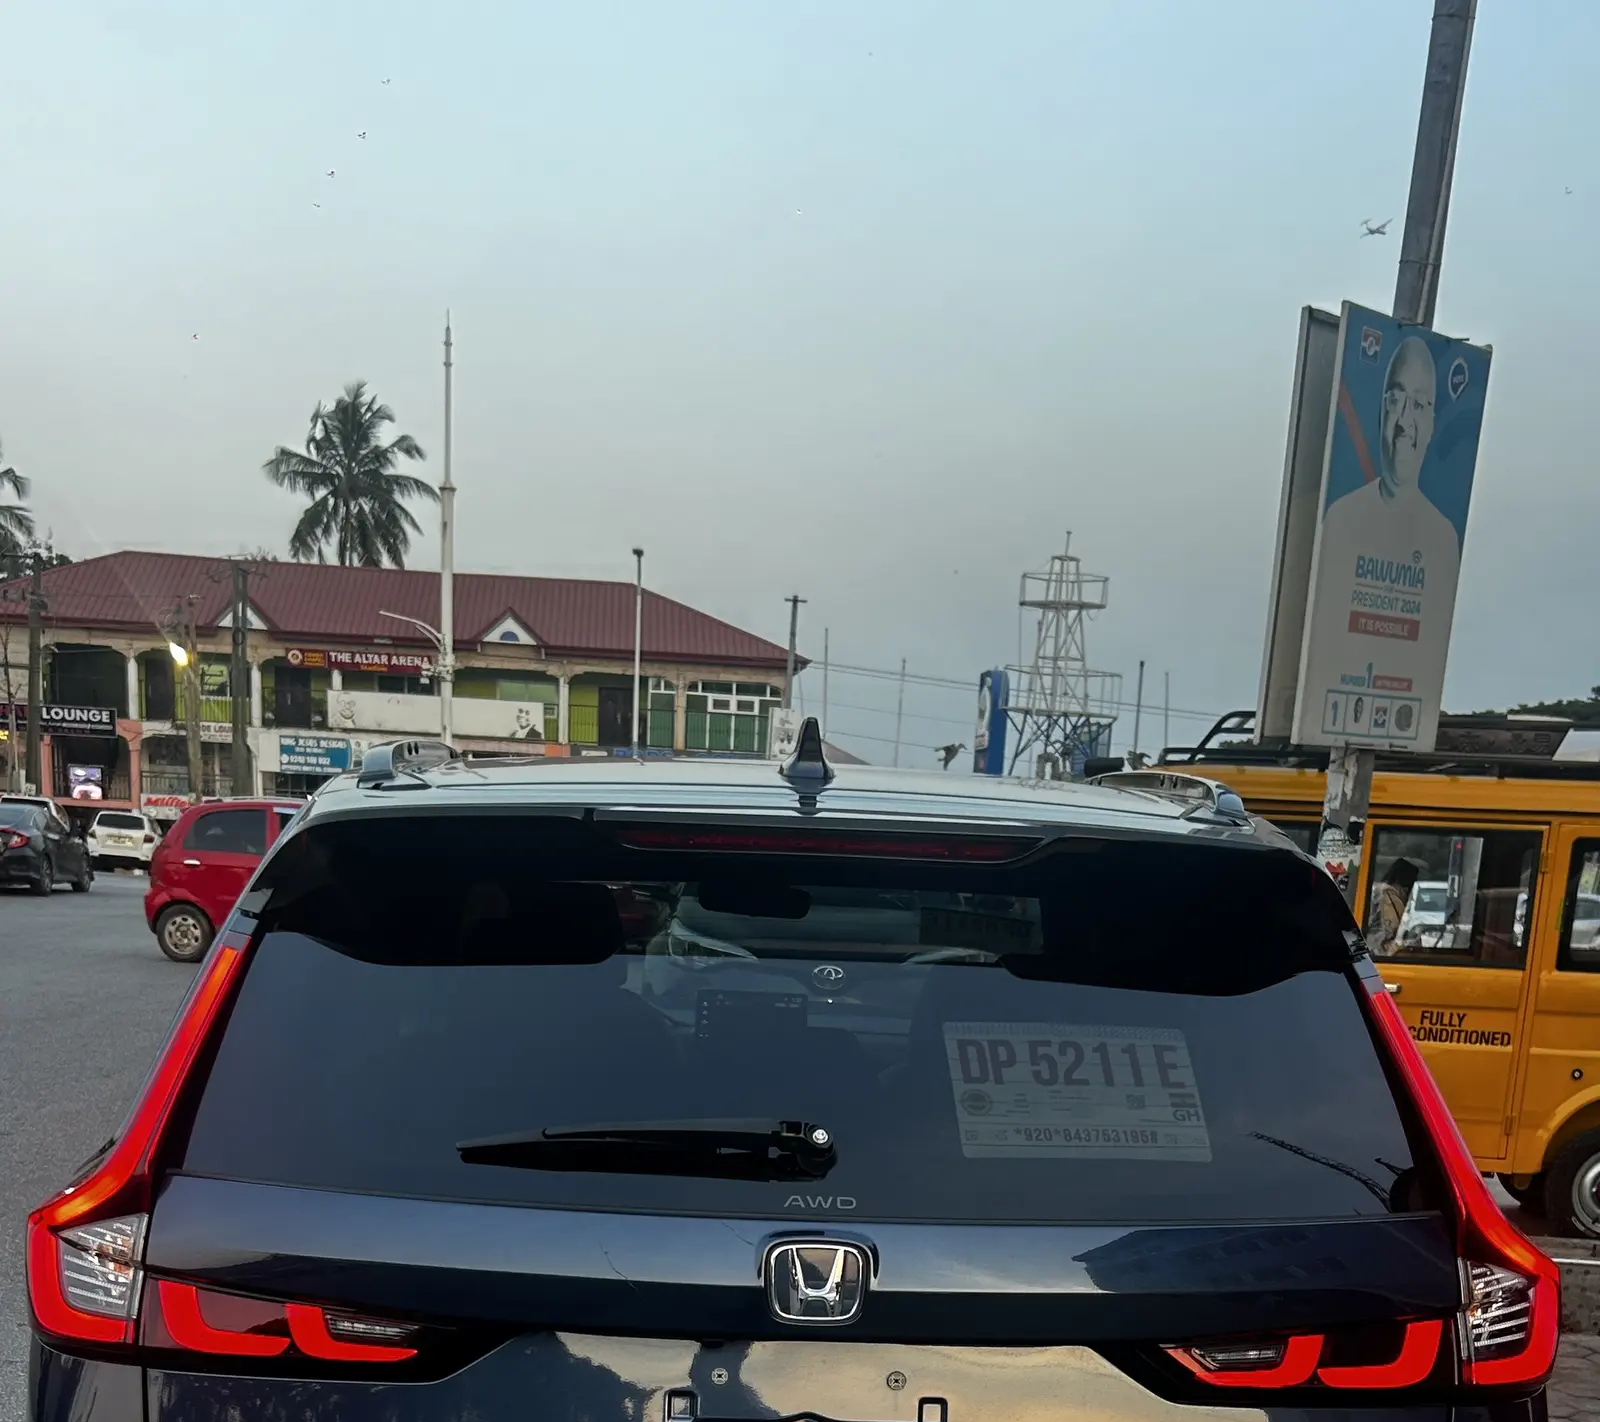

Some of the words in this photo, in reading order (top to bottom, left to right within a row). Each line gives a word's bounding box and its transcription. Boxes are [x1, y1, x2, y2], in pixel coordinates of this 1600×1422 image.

[1355, 555, 1425, 590] BAWUMIA
[1351, 589, 1400, 612] PRESIDENT
[1400, 598, 1421, 615] 2024
[329, 651, 352, 663] THE
[354, 653, 388, 666] ALTAR
[391, 655, 430, 668] ARENA
[1366, 662, 1373, 688] 1
[41, 707, 111, 723] LOUNGE
[1331, 700, 1339, 726] 1
[1420, 1009, 1467, 1028] FULLY
[956, 1039, 1018, 1085] DP
[1172, 1108, 1201, 1122] GH
[783, 1194, 858, 1210] AWD
